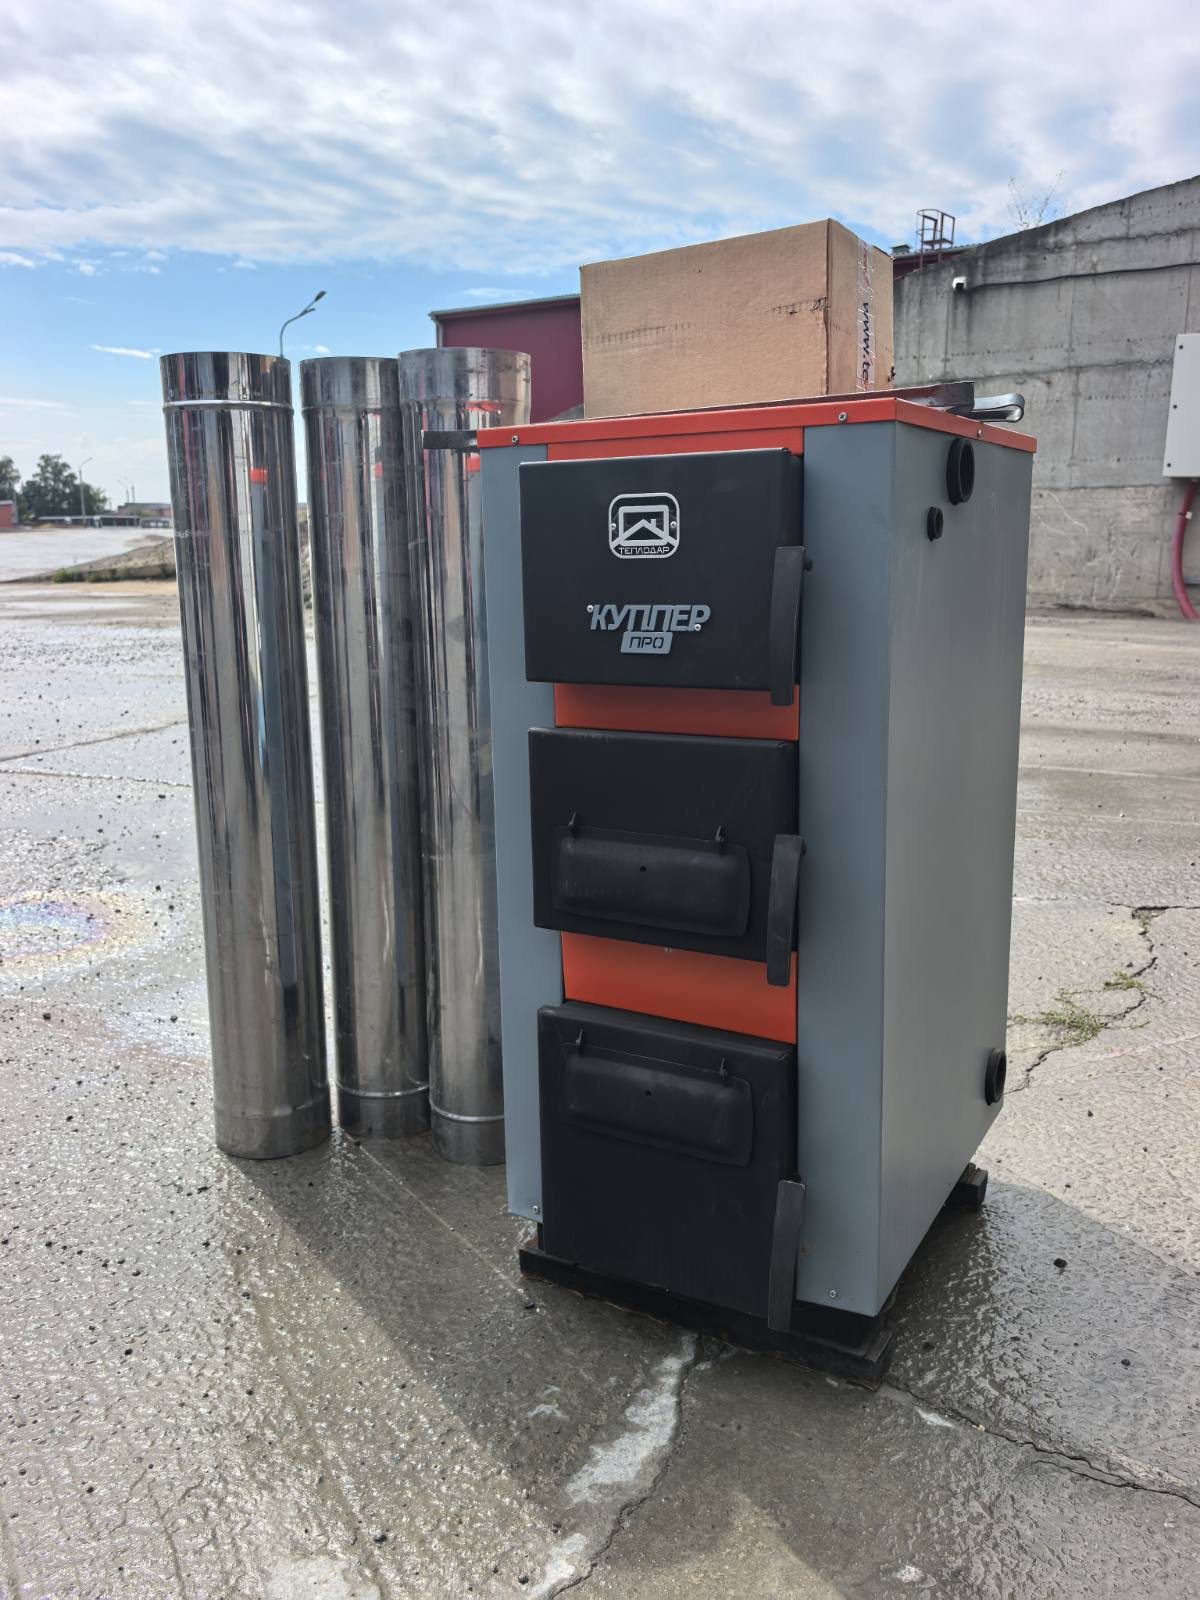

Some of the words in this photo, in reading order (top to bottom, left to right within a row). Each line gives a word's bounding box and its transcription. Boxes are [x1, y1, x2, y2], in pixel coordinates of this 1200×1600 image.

[618, 546, 670, 555] ТЕПЛОДАР
[590, 604, 711, 632] КУППЕР
[629, 636, 665, 649] ПРО
